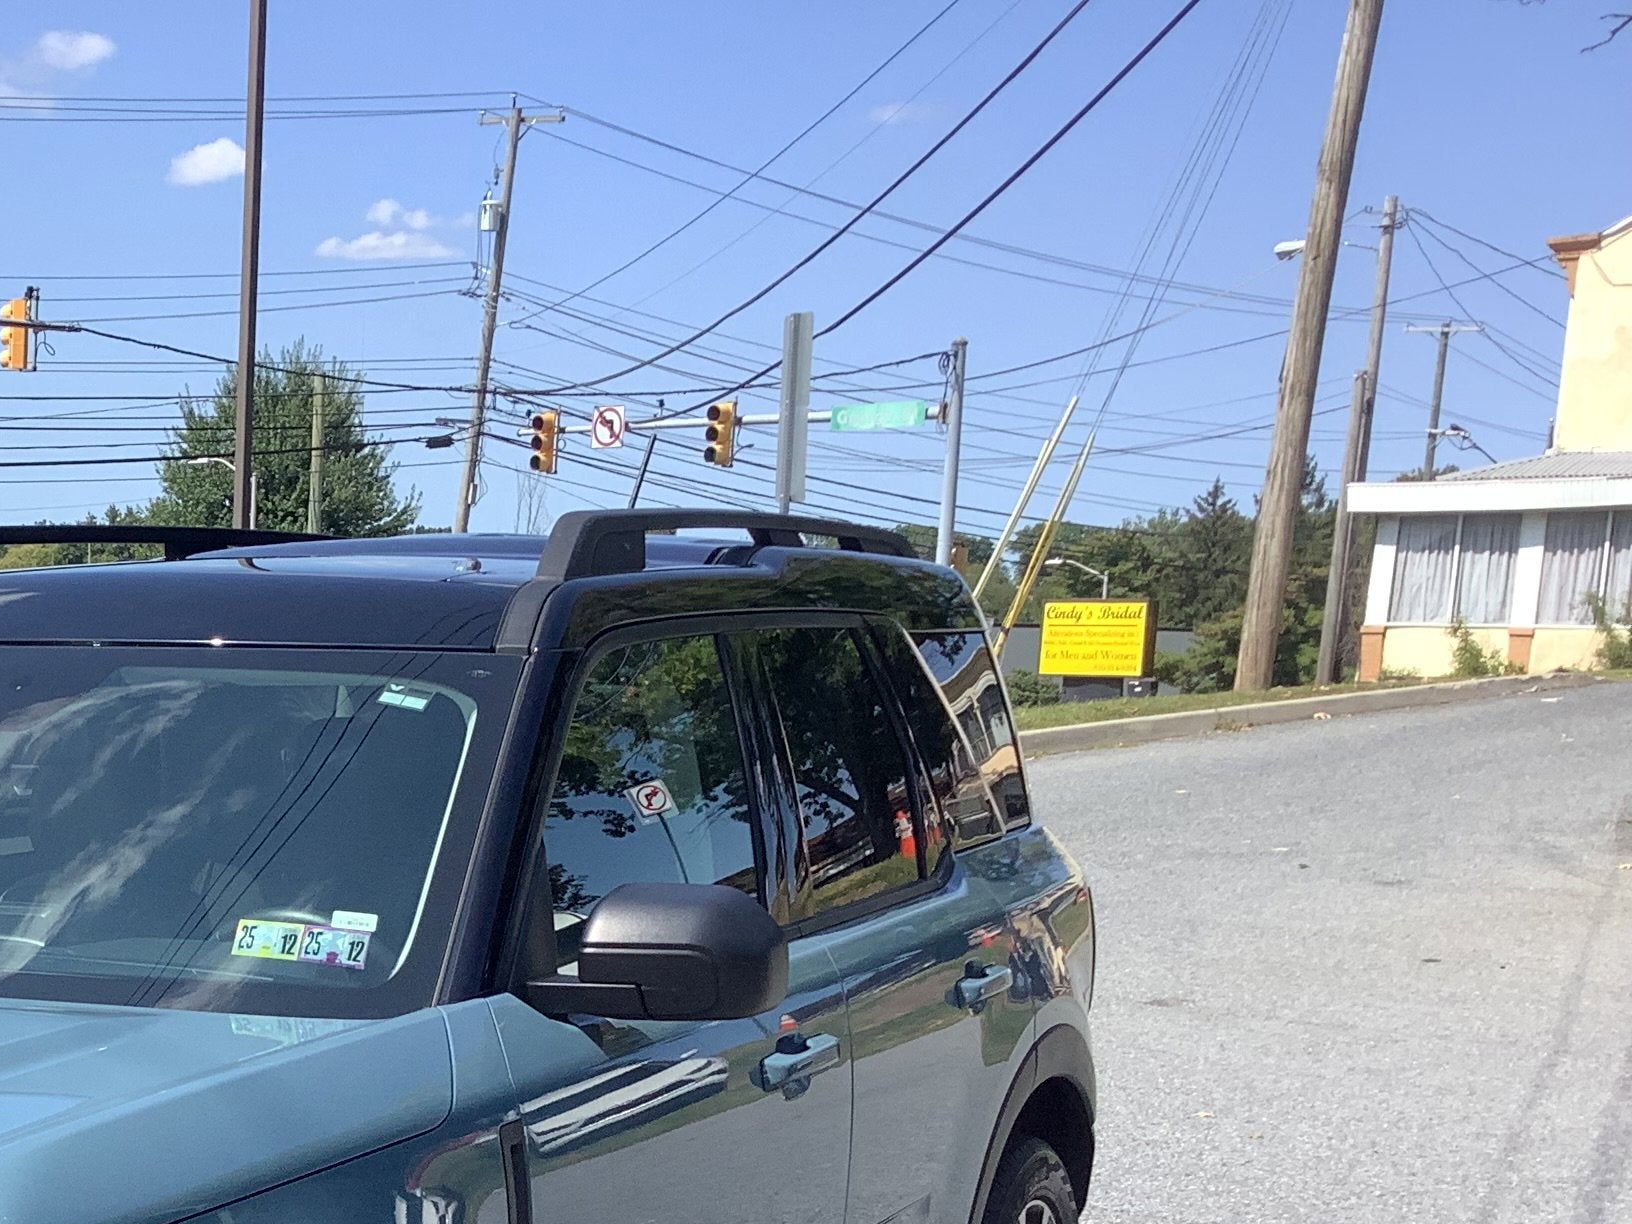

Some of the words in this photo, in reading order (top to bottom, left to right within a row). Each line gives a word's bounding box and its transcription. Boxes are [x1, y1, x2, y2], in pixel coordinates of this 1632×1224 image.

[1046, 605, 1093, 624] Cindy's
[1098, 605, 1145, 620] Bridal
[1060, 650, 1079, 660] Men
[1081, 650, 1098, 660] and
[1100, 650, 1137, 660] Women
[238, 924, 258, 949] 25
[280, 933, 298, 955] 12
[303, 930, 324, 956] 25
[346, 940, 366, 963] 12
